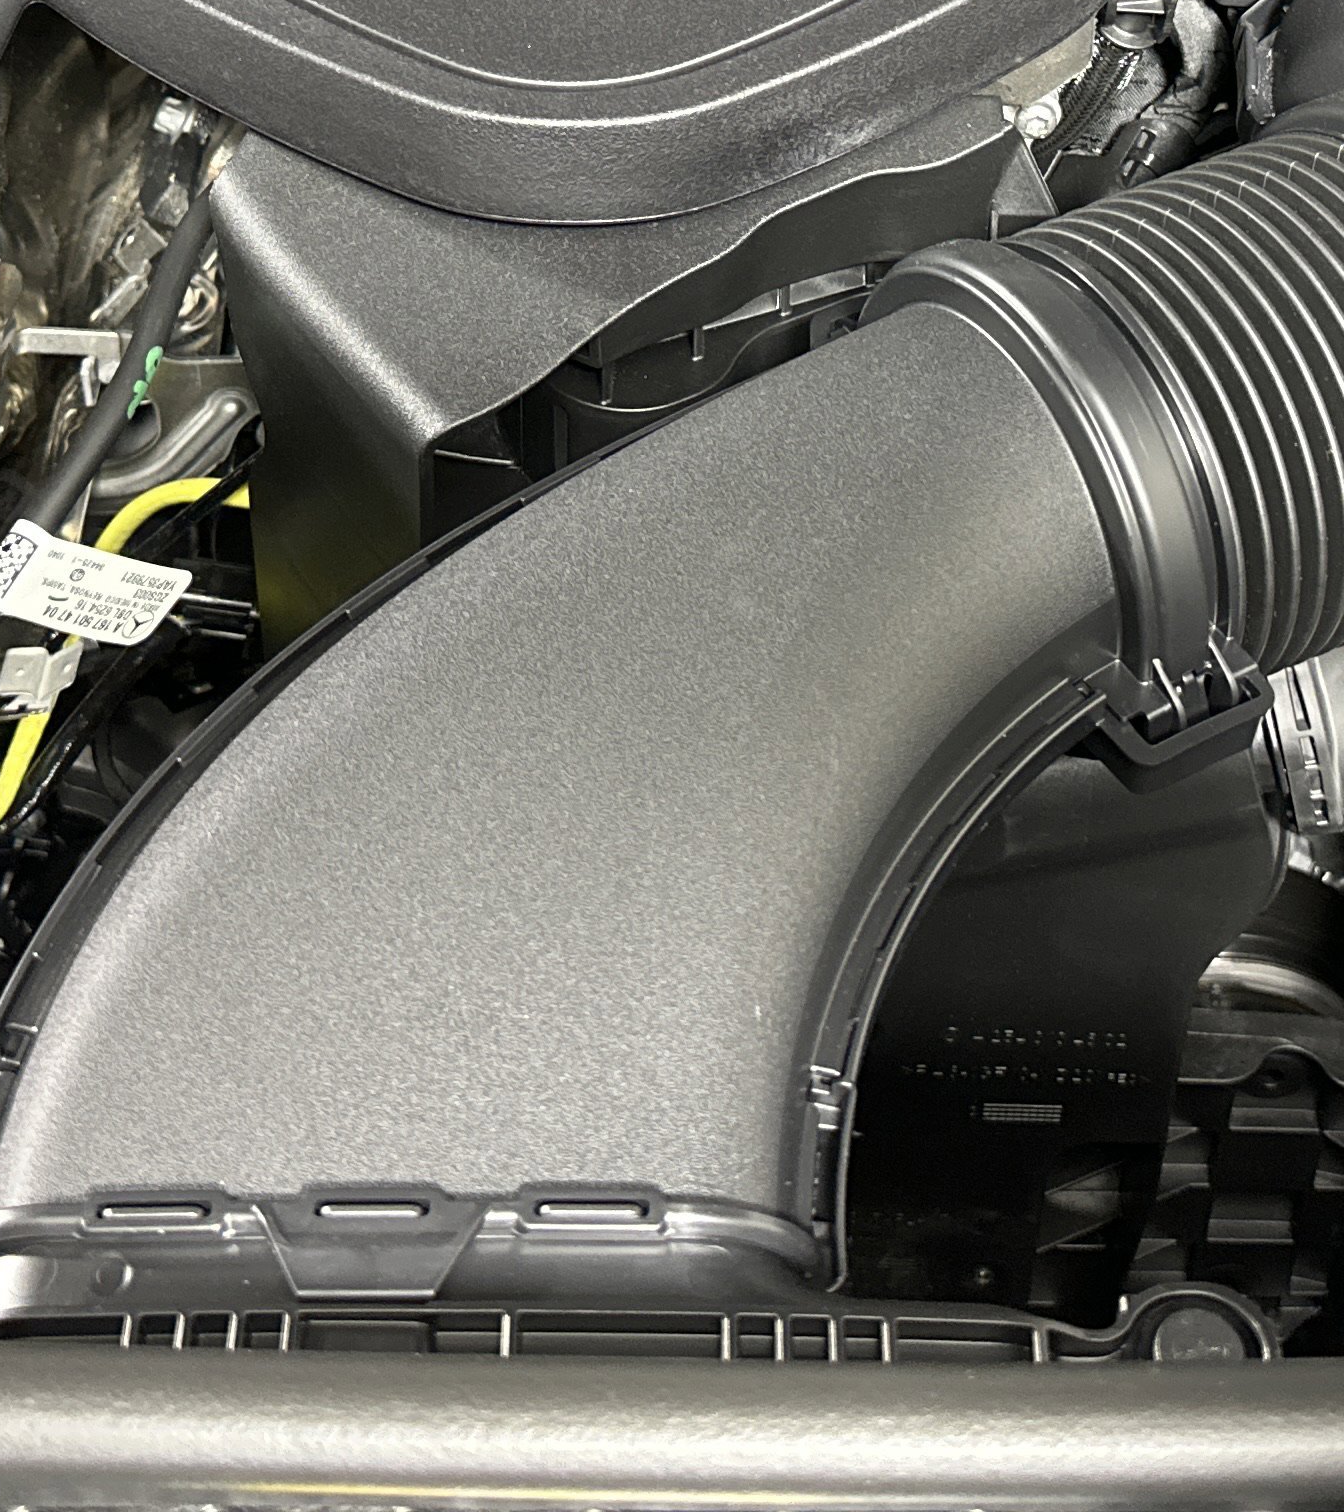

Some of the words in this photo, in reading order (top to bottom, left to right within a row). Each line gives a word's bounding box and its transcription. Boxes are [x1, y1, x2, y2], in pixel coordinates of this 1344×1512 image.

[43, 605, 58, 618] 04
[57, 609, 73, 622] 47
[73, 614, 94, 627] 501
[92, 619, 112, 629] 167
[113, 623, 123, 633] A
